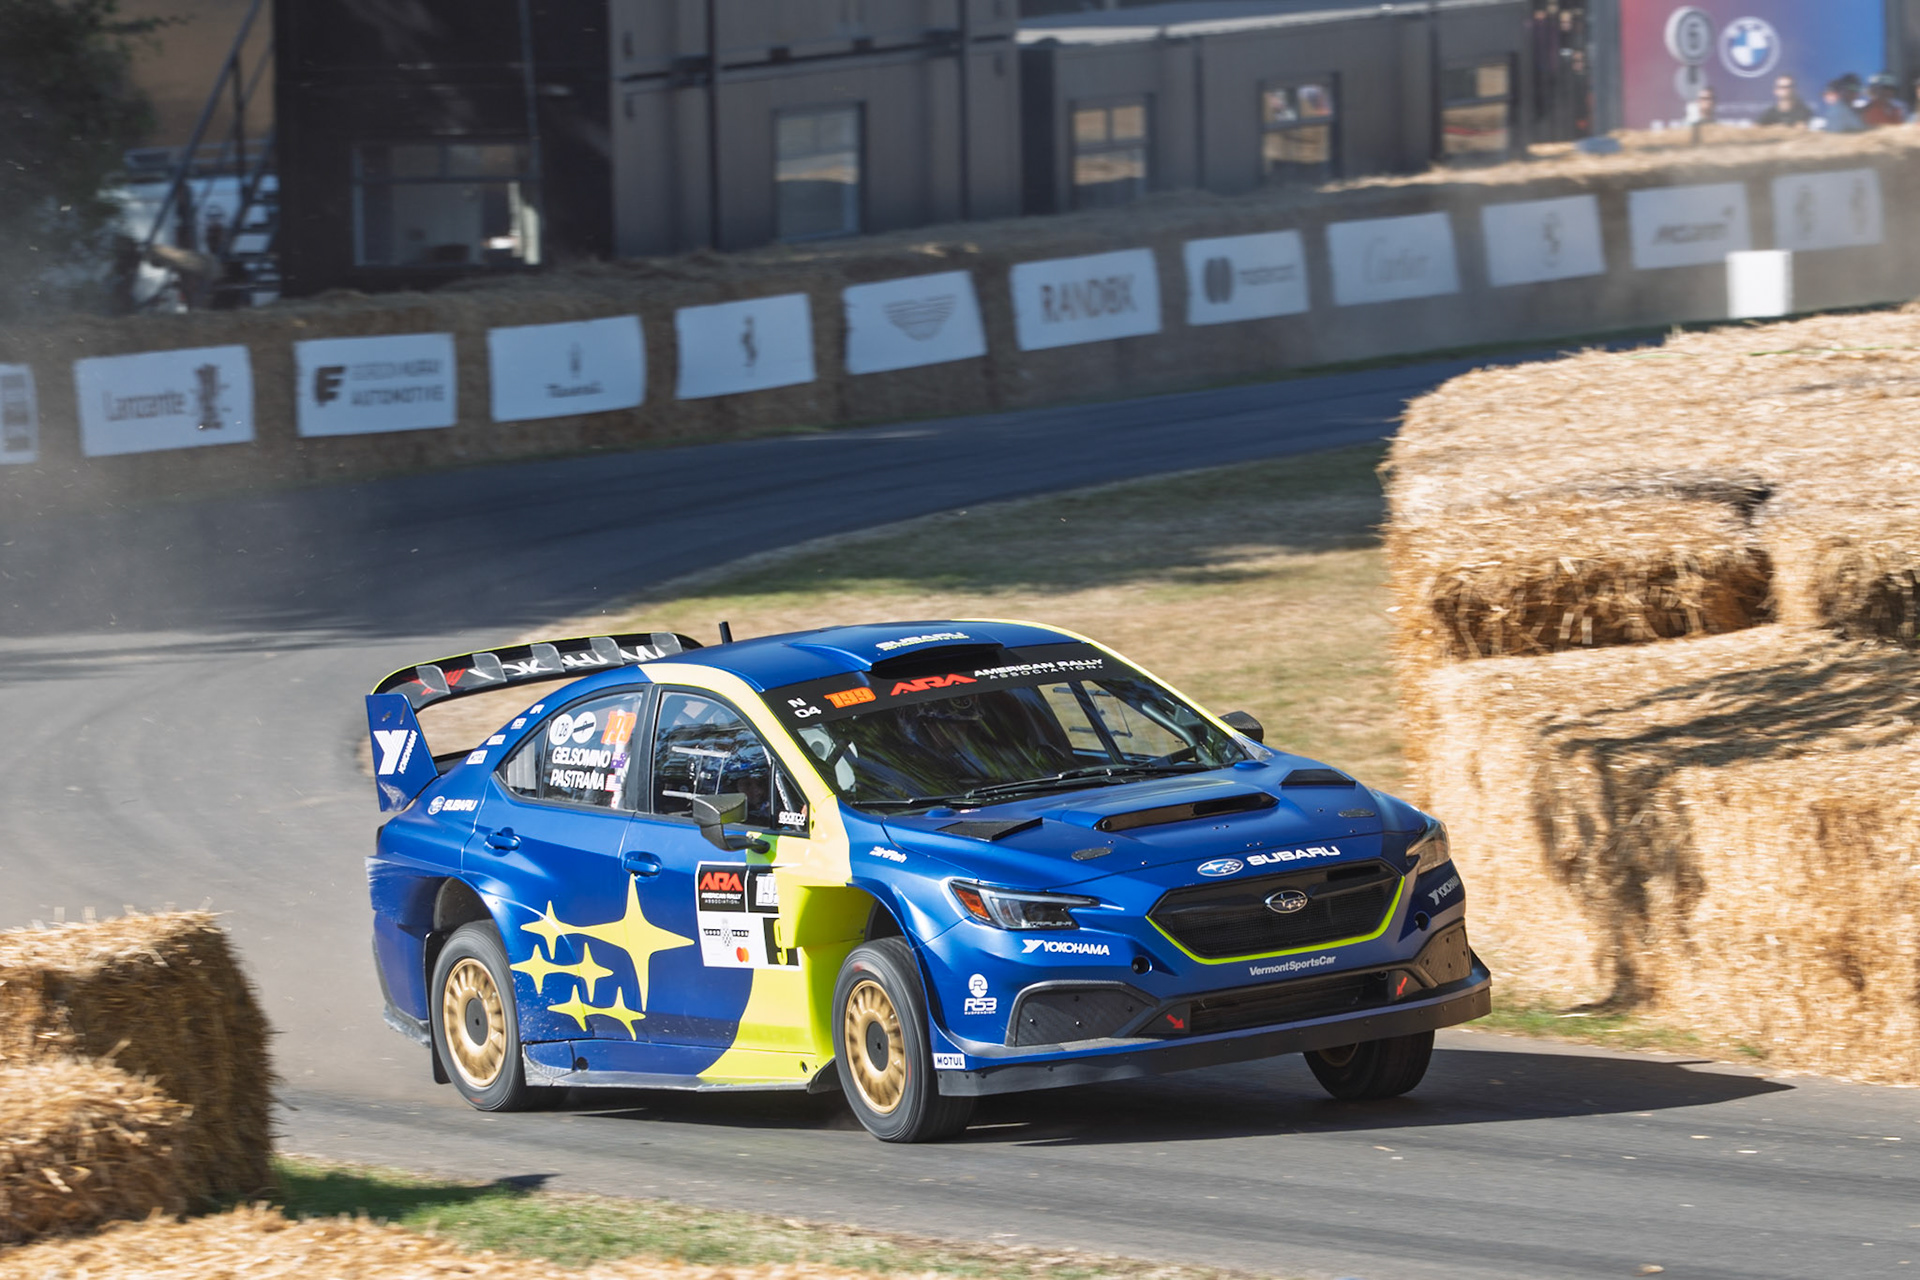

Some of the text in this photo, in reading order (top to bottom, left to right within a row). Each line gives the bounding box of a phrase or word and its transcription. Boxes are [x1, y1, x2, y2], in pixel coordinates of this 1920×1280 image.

[974, 659, 1103, 677] AMERICAN RALLY
[990, 665, 1098, 680] ASSOCIATION
[551, 746, 611, 768] GELSOMINO
[442, 800, 478, 811] SUBARU
[1246, 846, 1341, 866] SUBARU
[1043, 941, 1111, 956] YOKOHAMA
[936, 1057, 963, 1066] MOTUL
